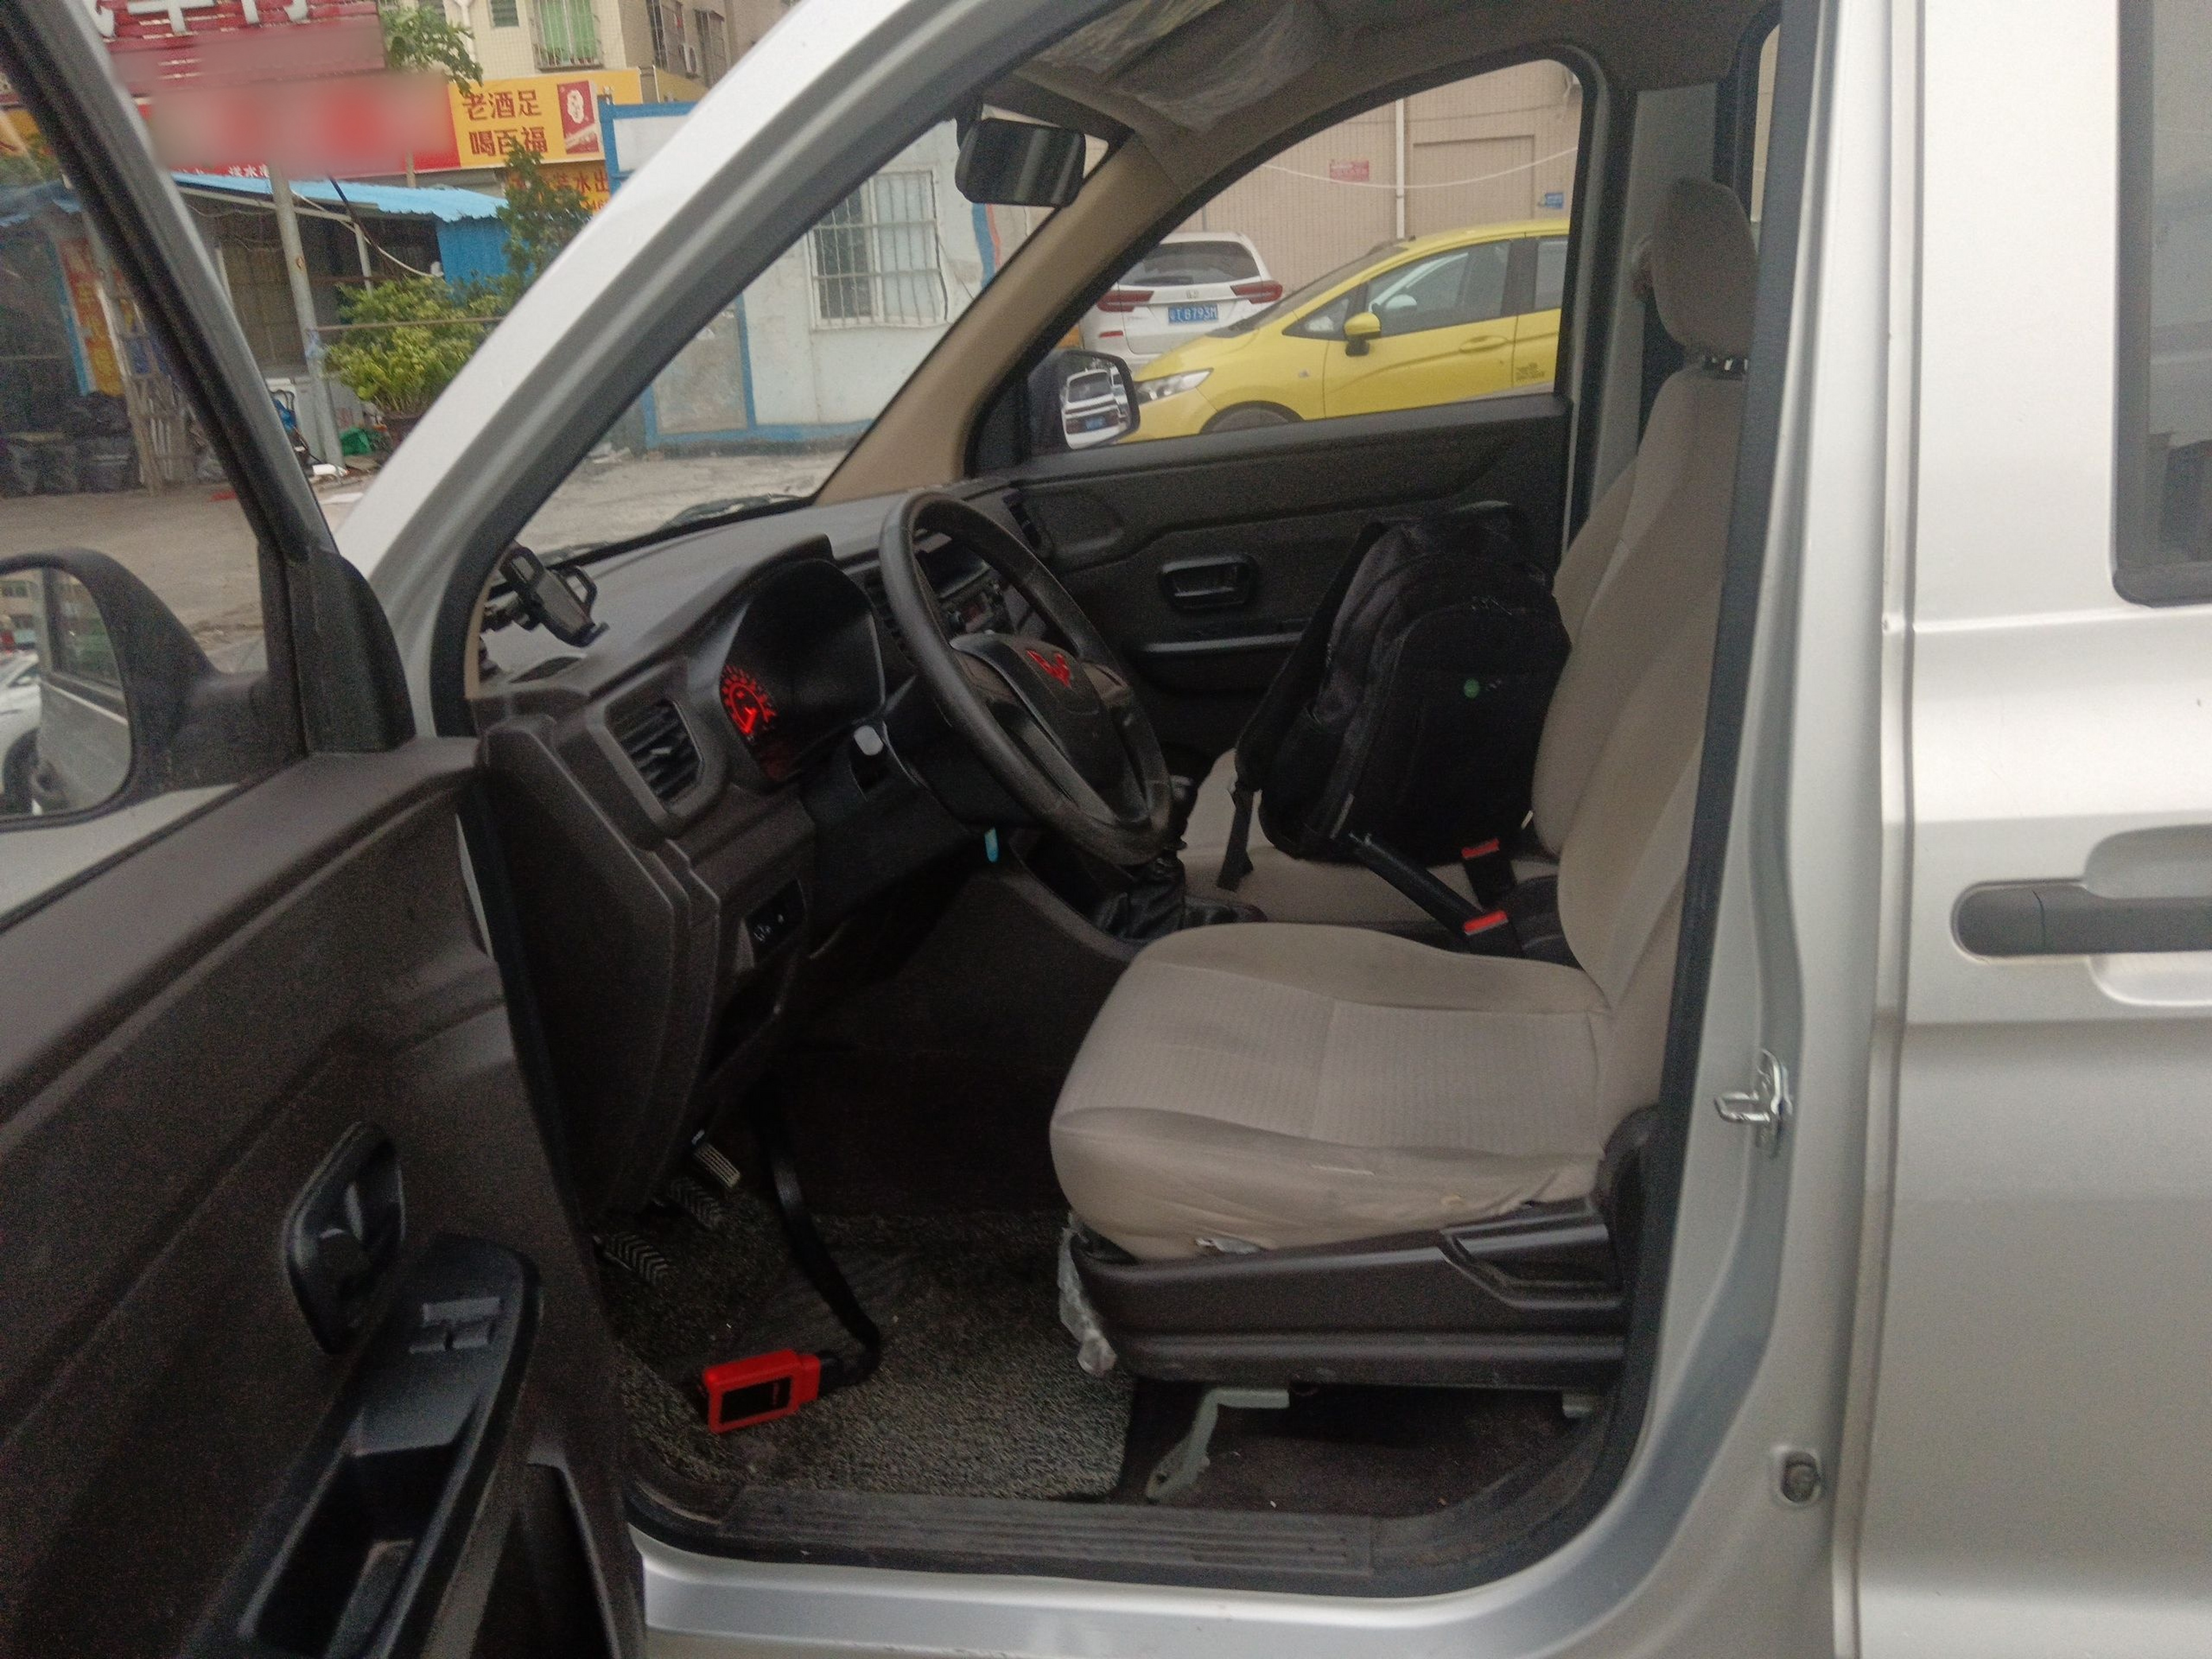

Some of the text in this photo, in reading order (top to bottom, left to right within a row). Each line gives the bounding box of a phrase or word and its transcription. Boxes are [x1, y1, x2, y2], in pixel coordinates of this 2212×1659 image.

[463, 89, 542, 120] 老酒足
[469, 126, 548, 156] 喝百福
